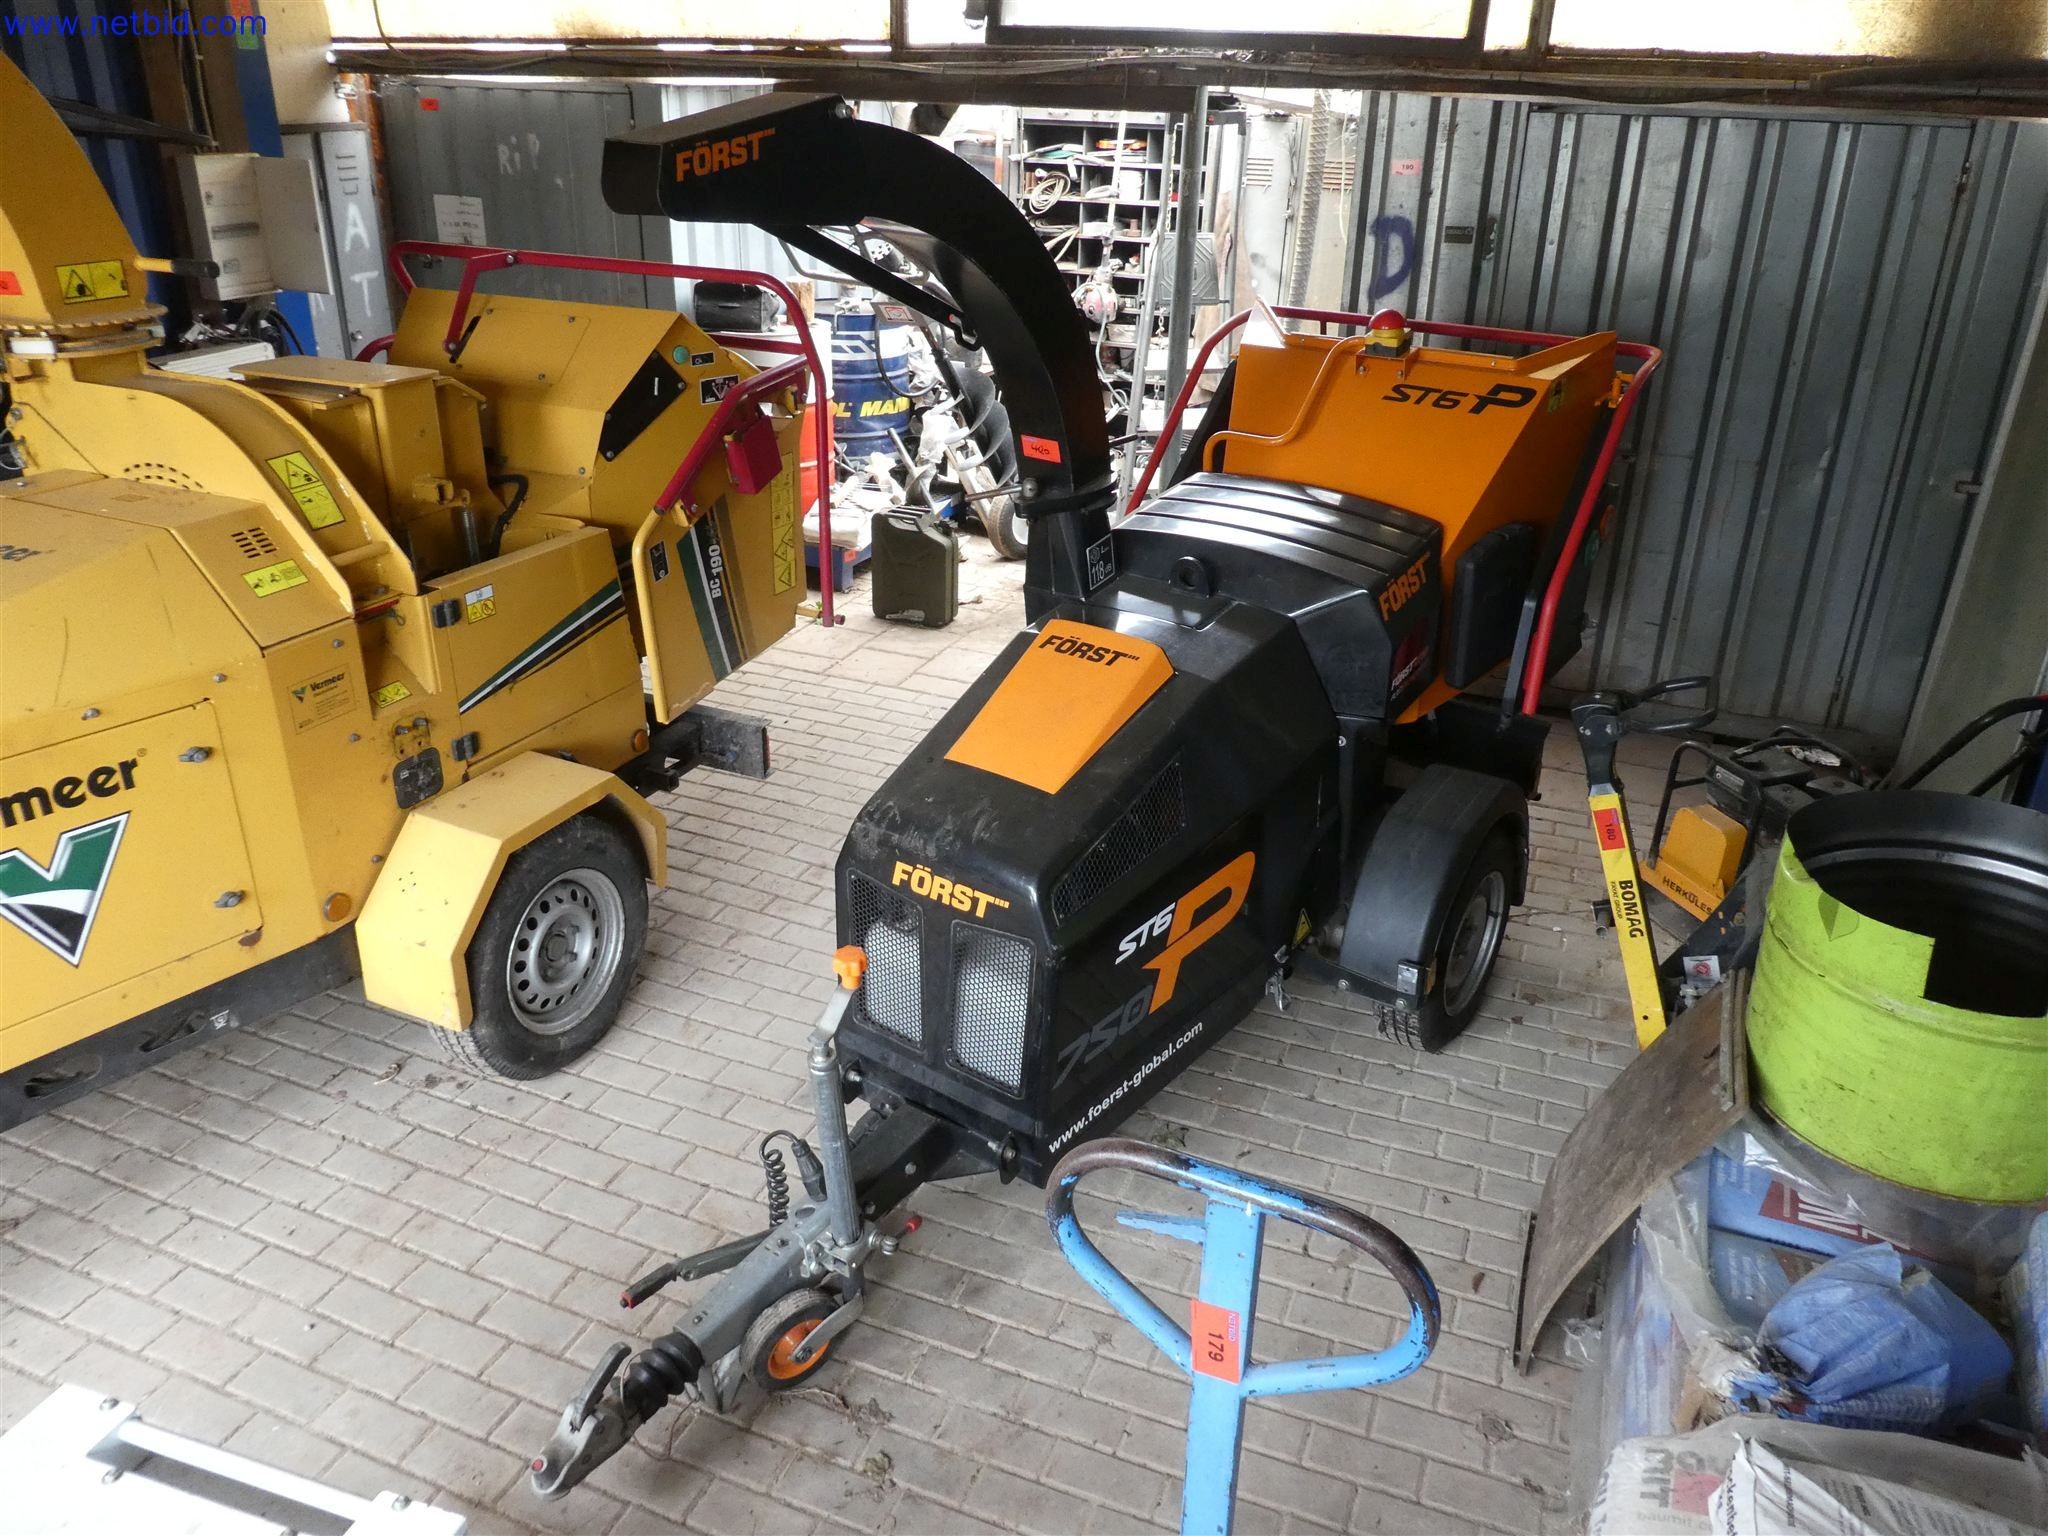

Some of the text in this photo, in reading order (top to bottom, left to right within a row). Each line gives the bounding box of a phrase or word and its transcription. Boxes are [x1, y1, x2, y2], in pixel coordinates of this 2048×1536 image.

[675, 128, 776, 182] FÖRST
[1369, 215, 1416, 300] D
[708, 544, 724, 599] BC 190
[1091, 560, 1105, 585] 118
[1379, 552, 1431, 621] FÖRST
[1038, 634, 1140, 667] FÖRST
[309, 672, 346, 692] Vermeer
[892, 860, 1010, 919] FÖRST
[1618, 879, 1645, 939] BOMAG
[1114, 902, 1176, 965] ST6
[1048, 1021, 1203, 1154] www.foerst-global.com
[1208, 1332, 1225, 1363] 179
